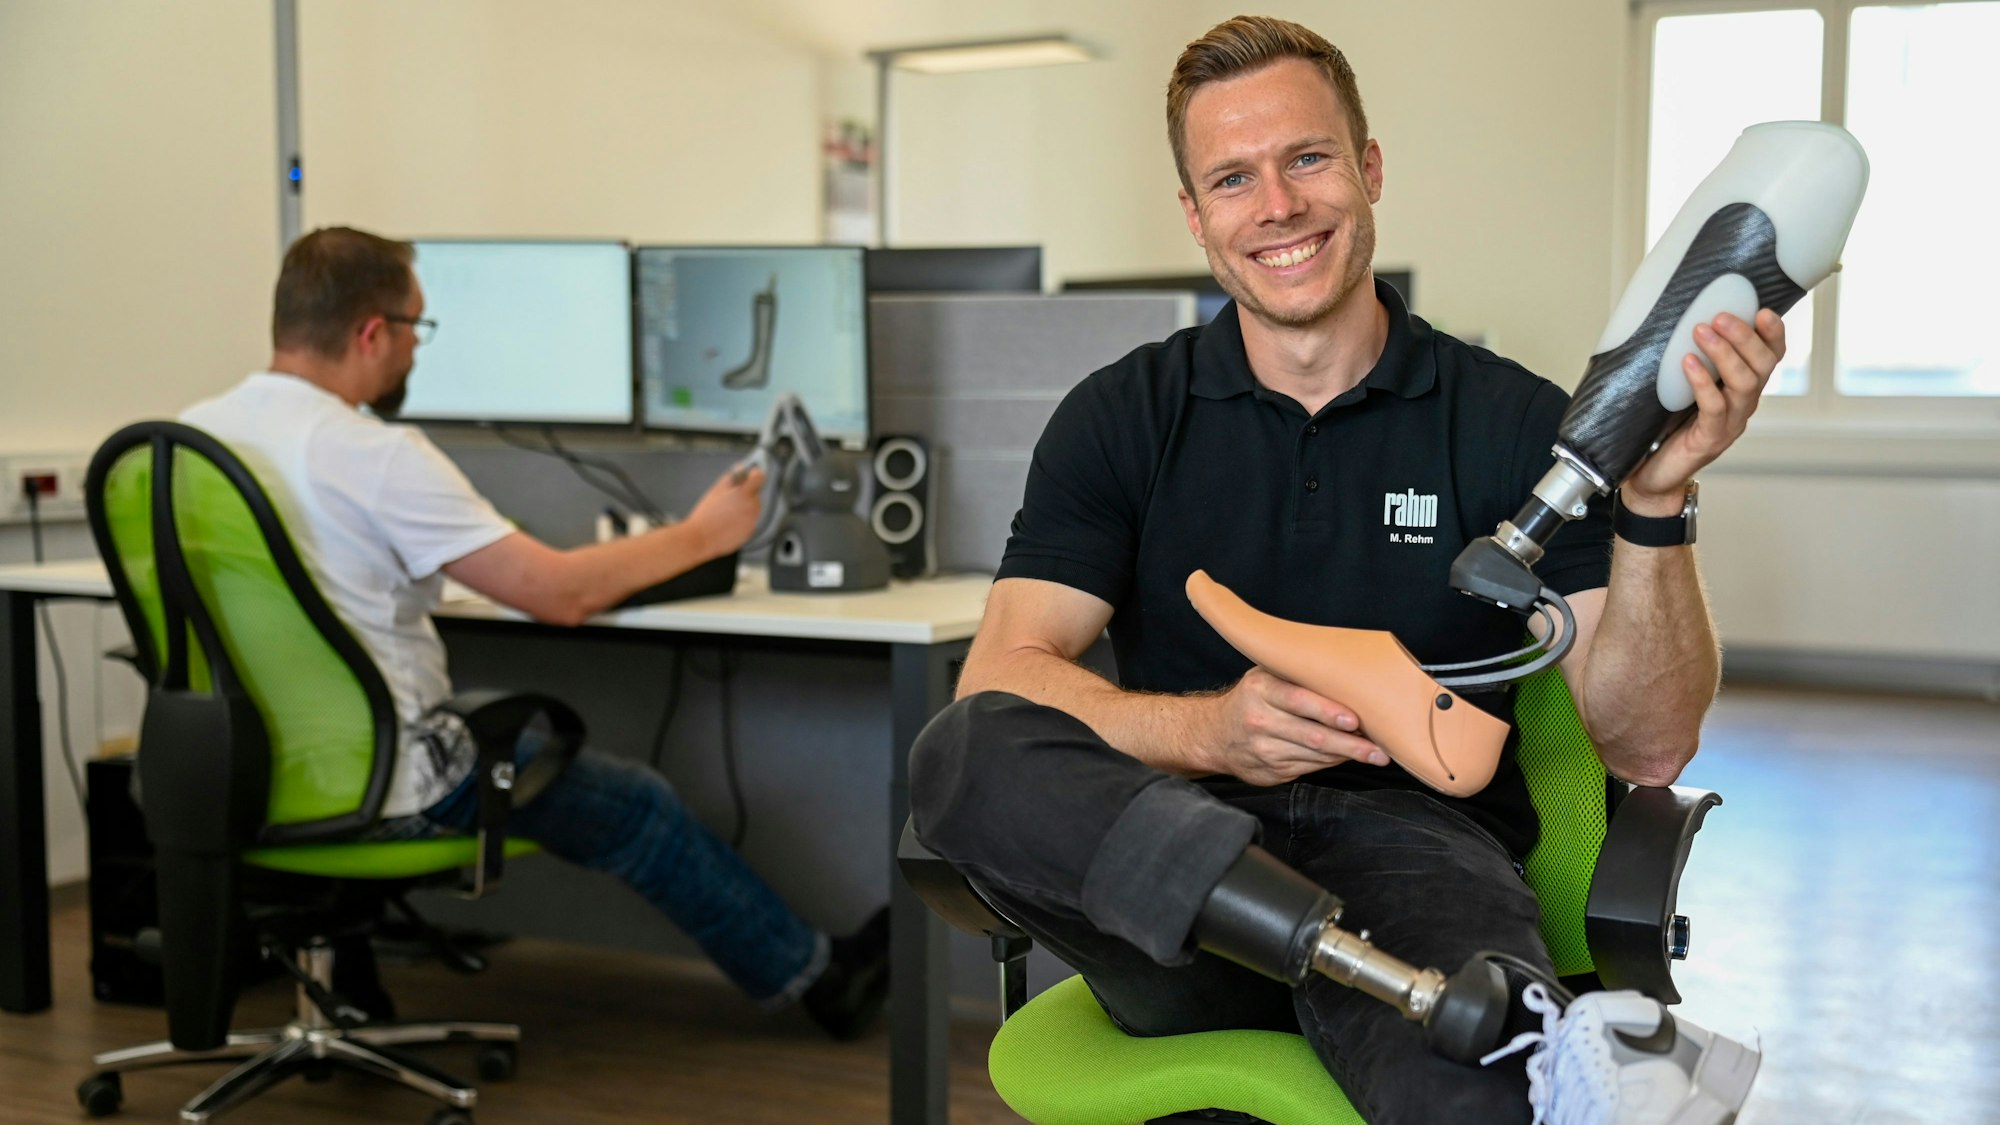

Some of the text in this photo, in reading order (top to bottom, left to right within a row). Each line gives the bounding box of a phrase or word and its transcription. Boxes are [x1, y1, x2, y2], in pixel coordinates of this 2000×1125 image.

[1384, 488, 1438, 527] rahm
[1390, 533, 1434, 544] M. Rehm
